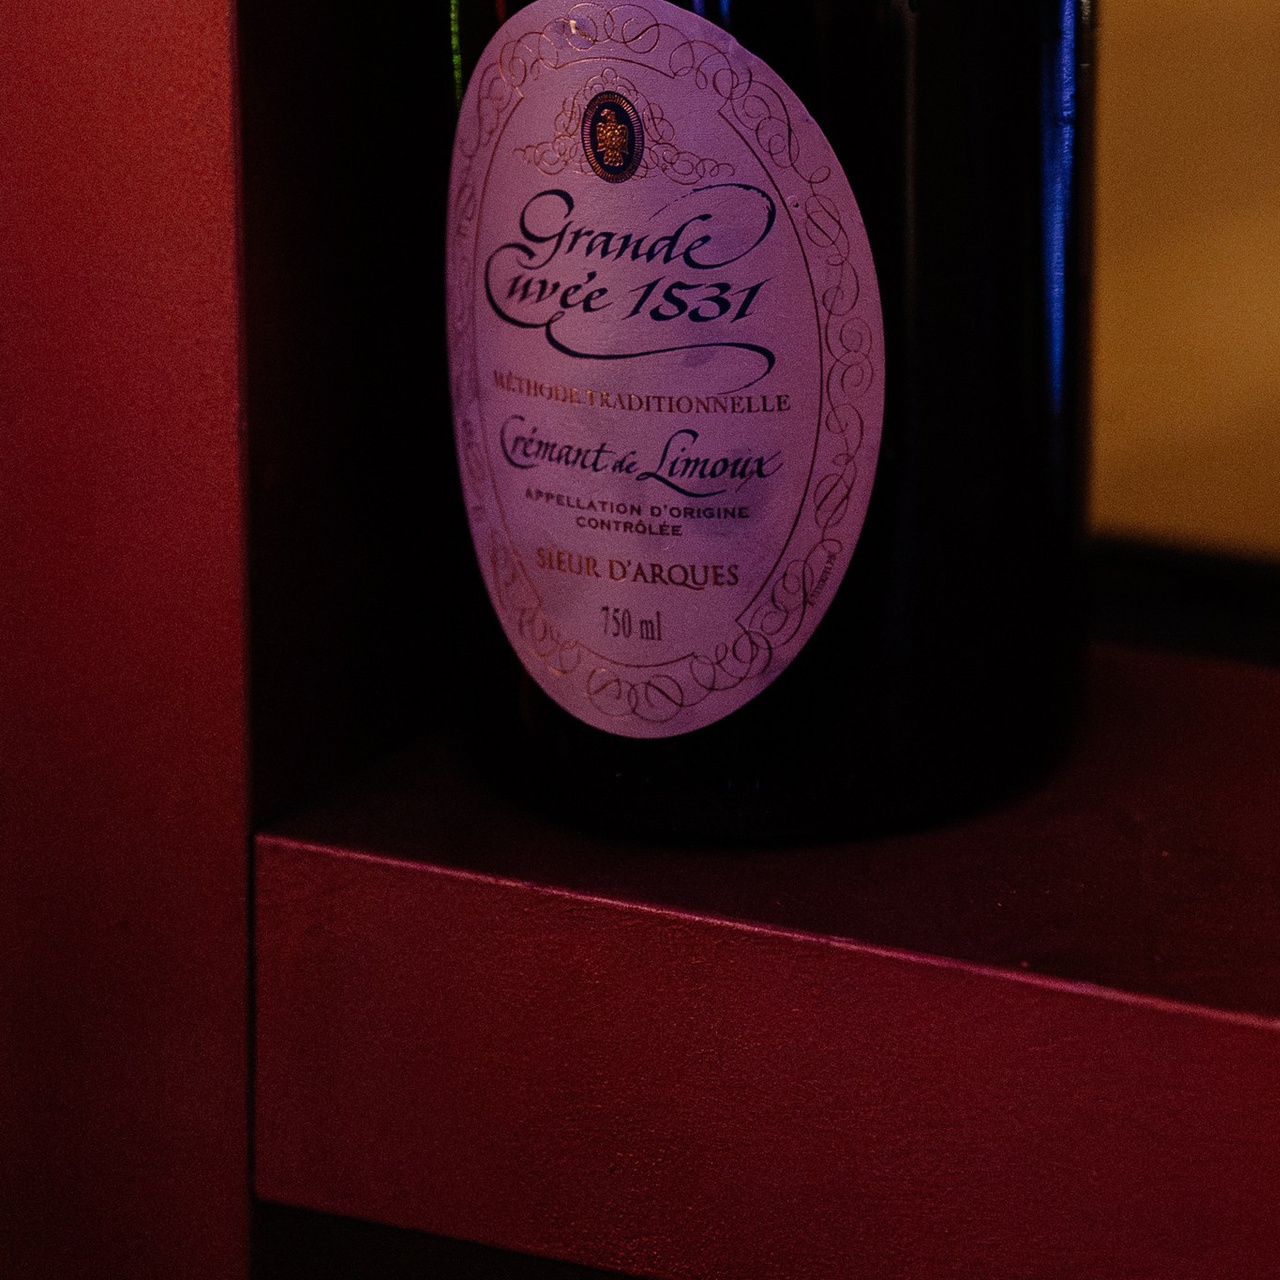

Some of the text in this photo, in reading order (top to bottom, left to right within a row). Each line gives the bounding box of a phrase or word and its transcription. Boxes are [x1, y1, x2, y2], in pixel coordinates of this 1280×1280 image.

[519, 183, 776, 269] Grande
[621, 276, 772, 323] 1531
[493, 369, 791, 414] MÉTHODE TRADITIONNELLE
[500, 414, 783, 498] Crémant de Limoux
[525, 488, 749, 519] APPELLATION D'ORIGINE
[576, 515, 683, 536] CONTRÔLÉE
[535, 545, 740, 591] SIEUR D'ARQUES
[601, 605, 663, 641] 750 ml
